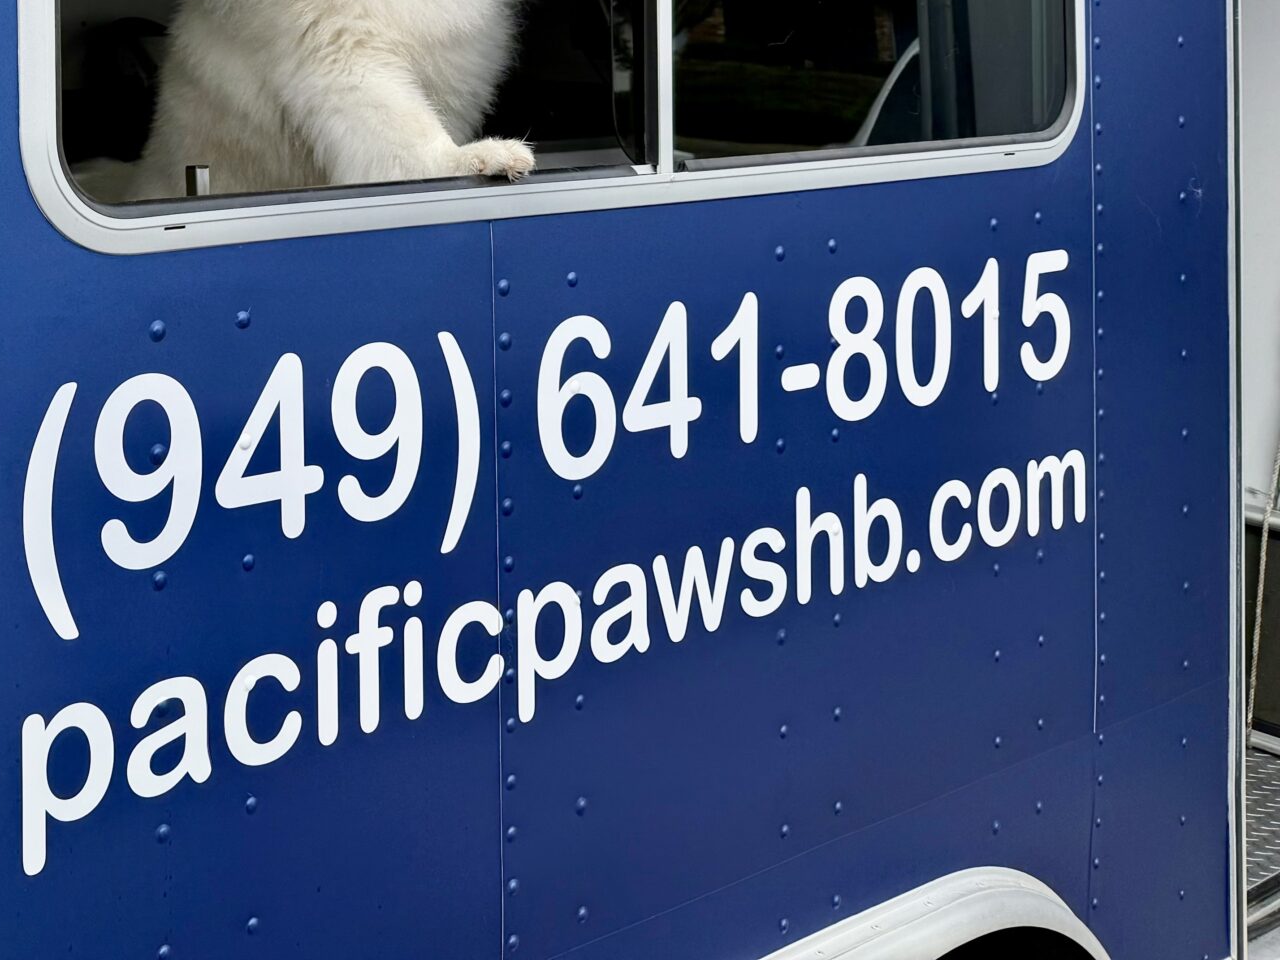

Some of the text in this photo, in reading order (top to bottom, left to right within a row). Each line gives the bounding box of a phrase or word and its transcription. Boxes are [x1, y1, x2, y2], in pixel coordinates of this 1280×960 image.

[22, 249, 1071, 640] (949) 641-8015
[21, 449, 1086, 876] pacificpawshb.com
